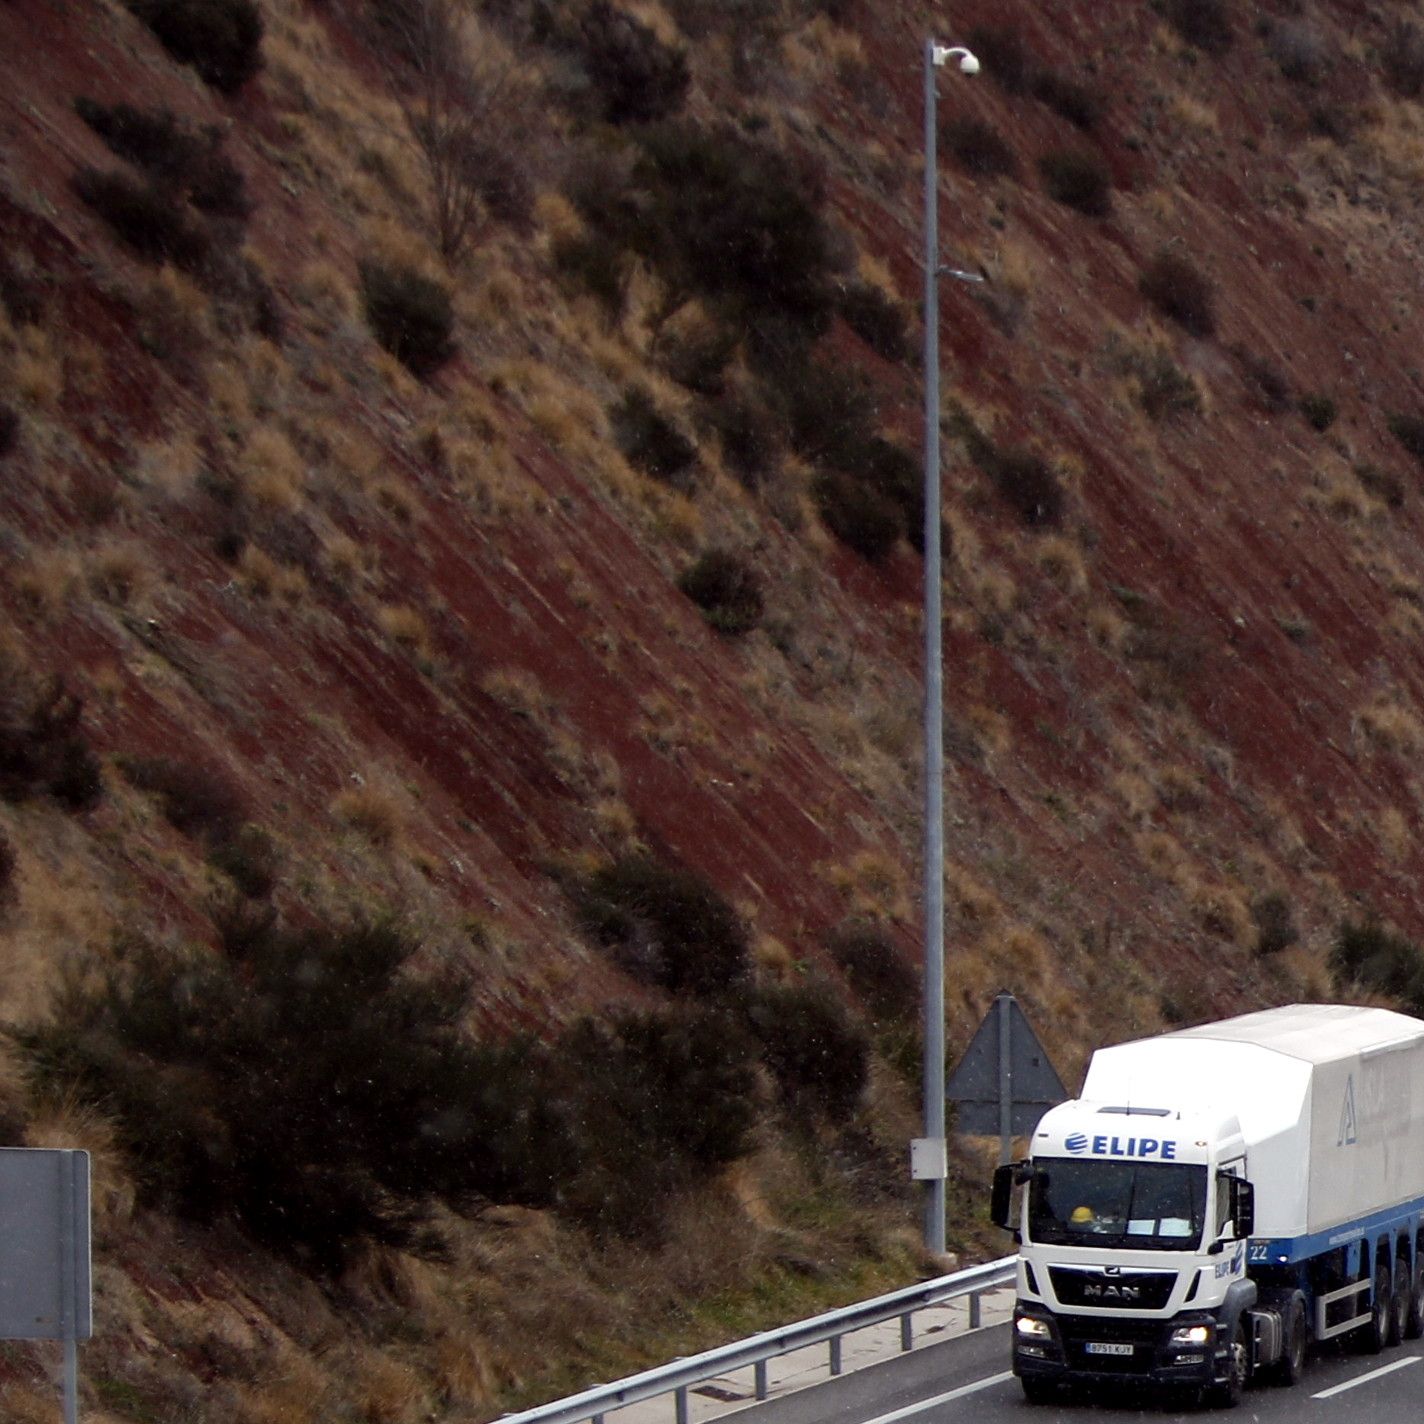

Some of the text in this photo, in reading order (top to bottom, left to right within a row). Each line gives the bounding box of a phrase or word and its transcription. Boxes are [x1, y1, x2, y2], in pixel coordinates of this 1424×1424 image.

[1092, 1135, 1177, 1159] ELIPE
[1250, 1245, 1268, 1260] 22
[1084, 1285, 1139, 1298] MAN
